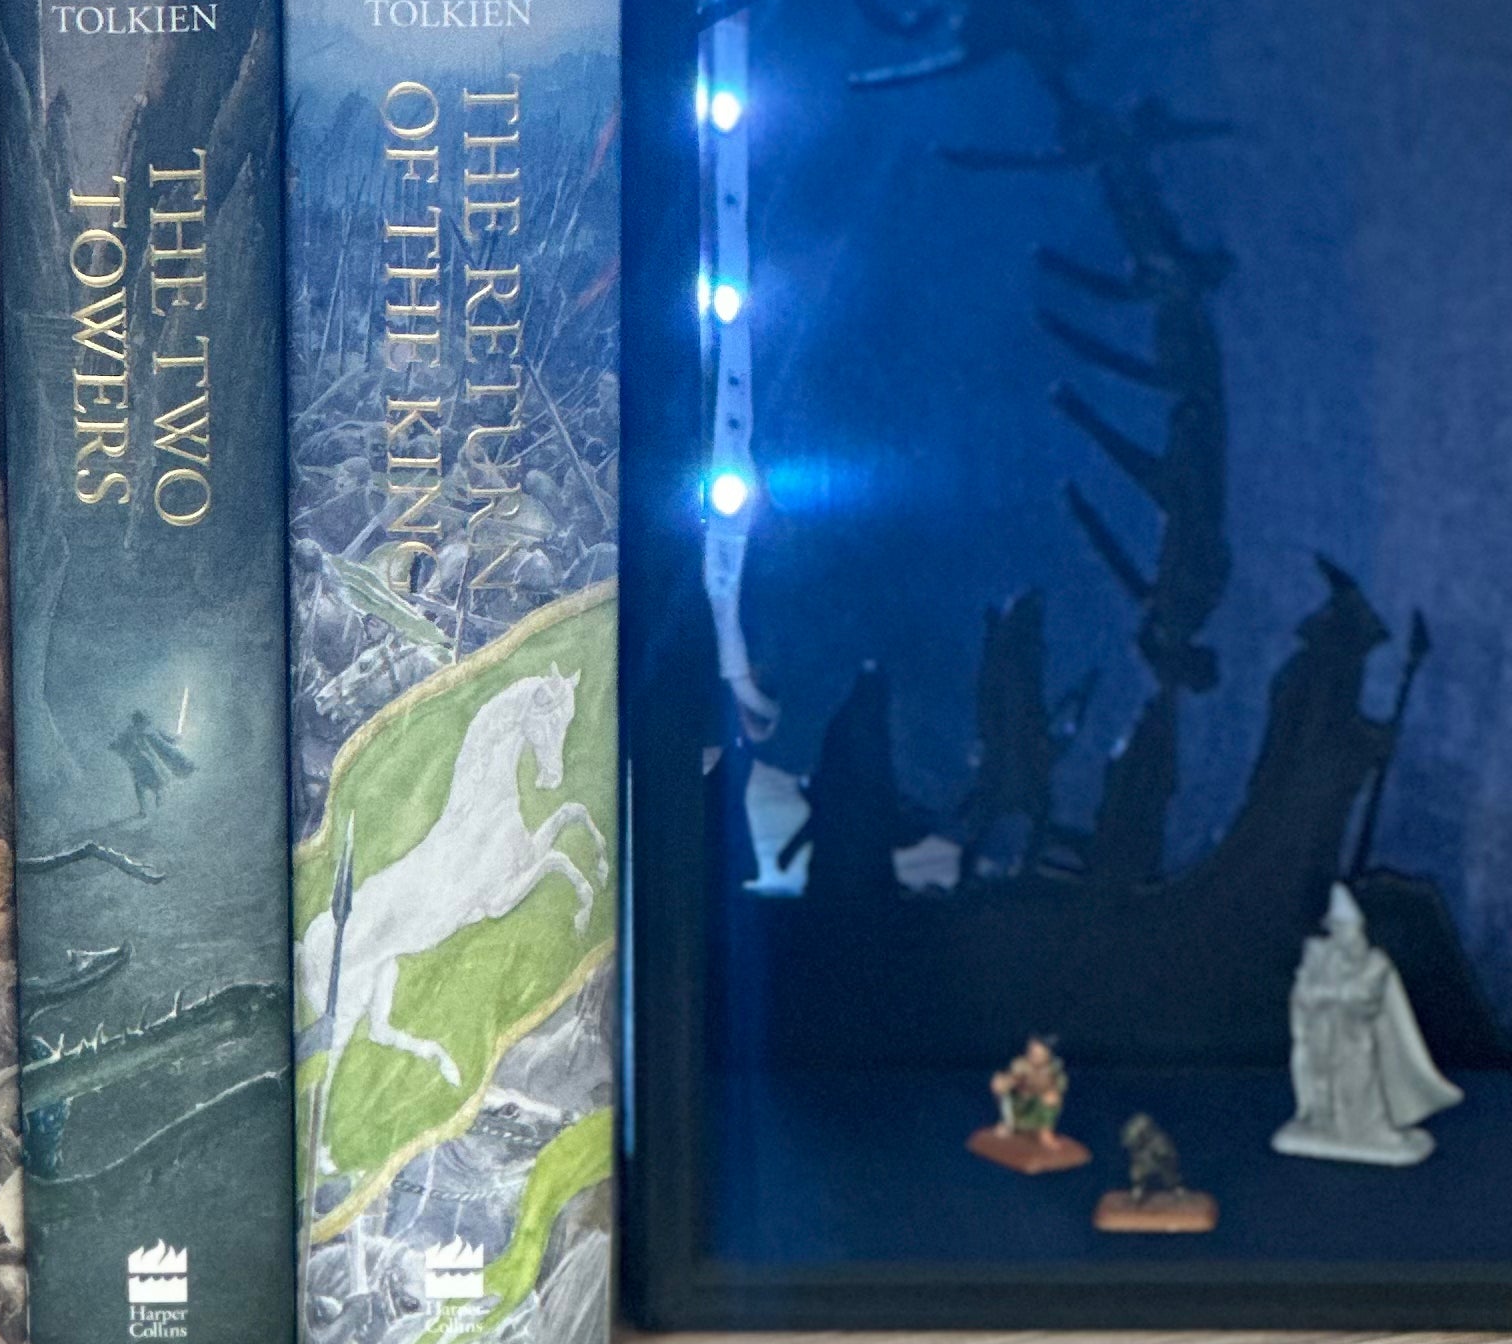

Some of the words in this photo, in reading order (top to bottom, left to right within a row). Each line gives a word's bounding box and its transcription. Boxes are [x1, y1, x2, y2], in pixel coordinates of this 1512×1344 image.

[51, 3, 219, 35] TOLKIEN
[381, 80, 440, 184] OF
[463, 73, 522, 242] THE
[148, 146, 208, 317] THE
[384, 205, 443, 370] THE
[68, 174, 131, 505] TOWERS
[152, 334, 212, 527] TWO
[387, 396, 443, 594] KING
[464, 263, 524, 611] RETURN
[129, 1305, 188, 1326] Harper
[129, 1321, 188, 1339] Collins
